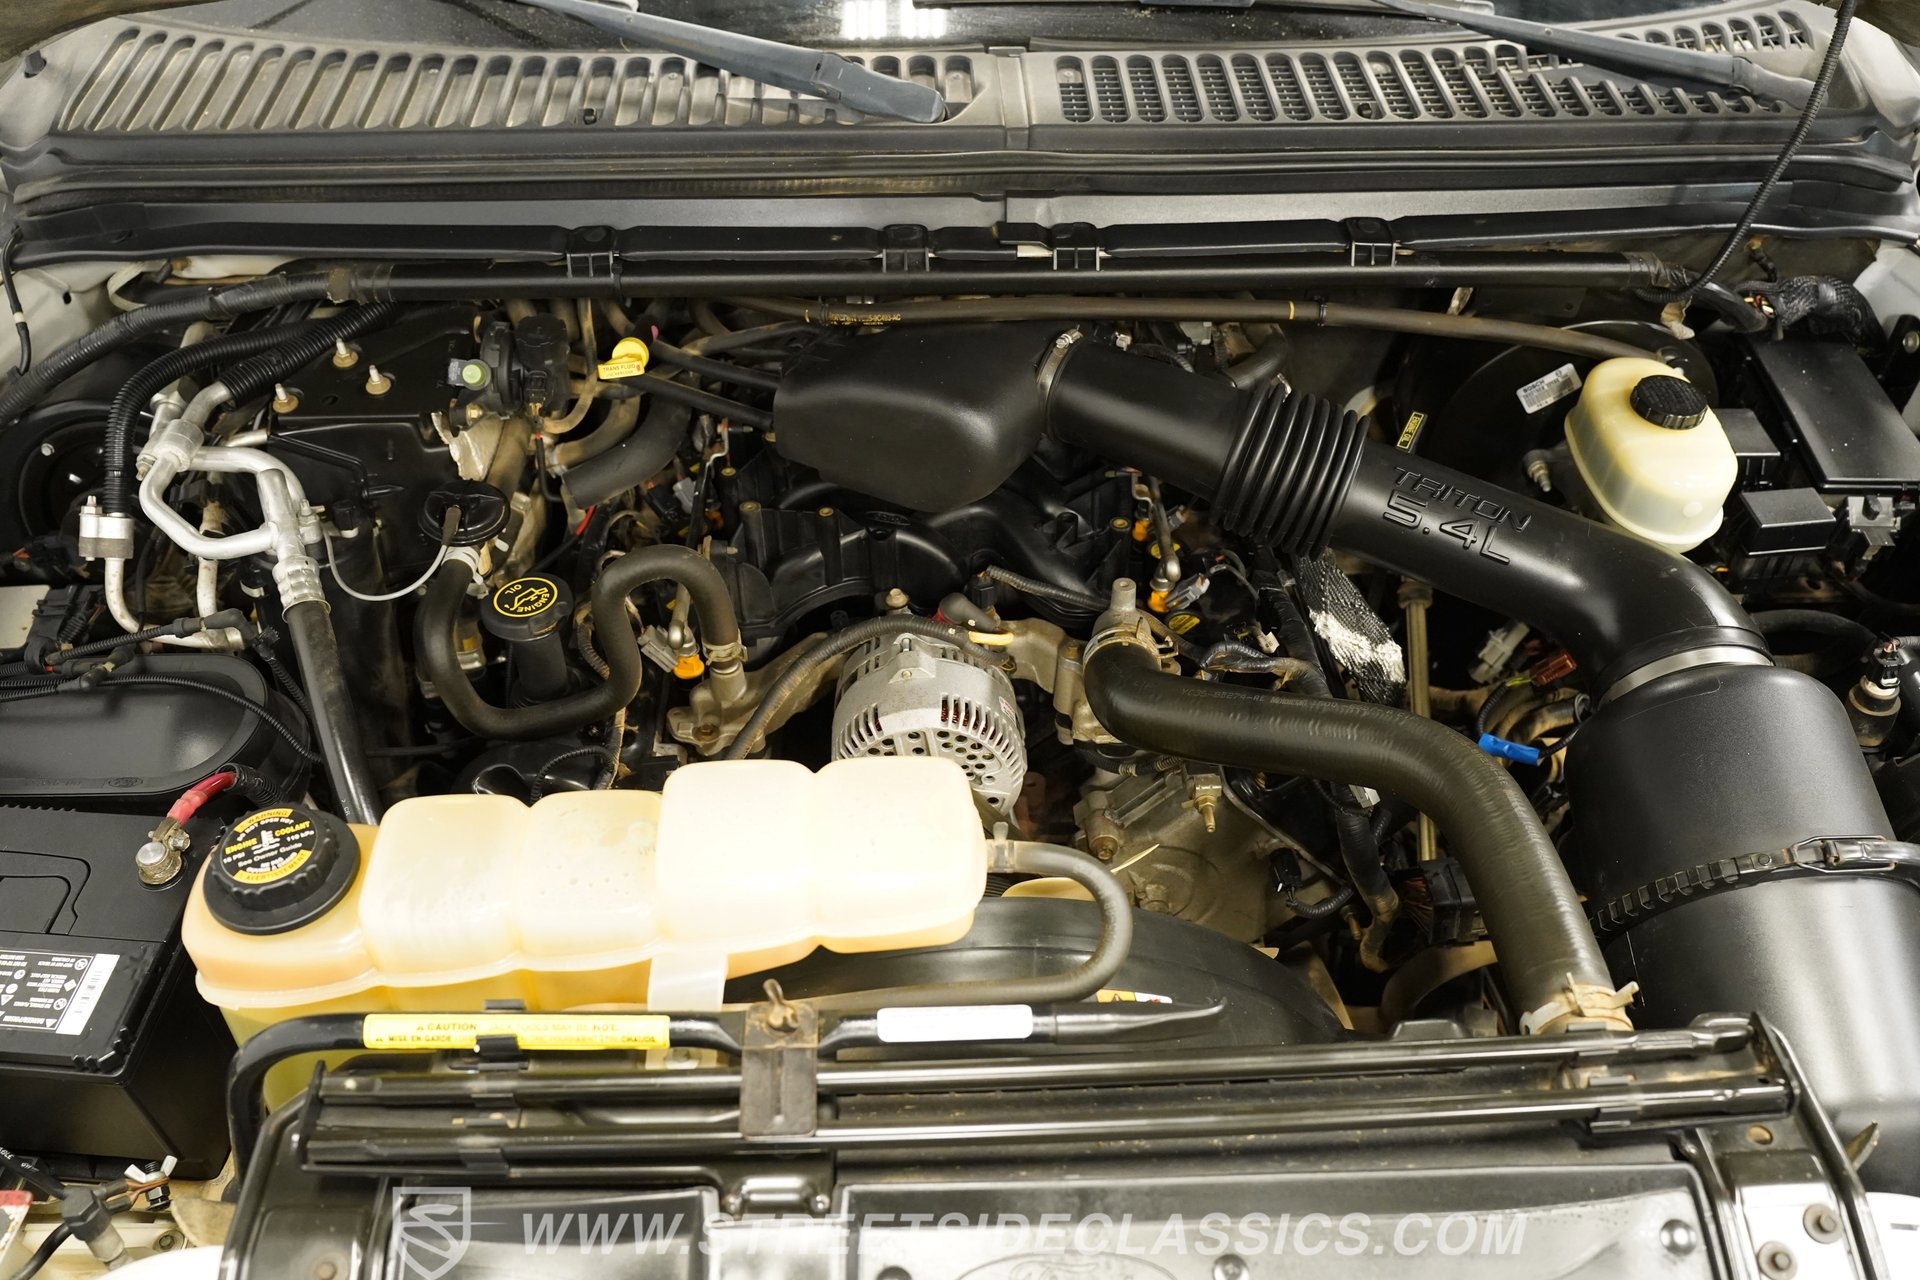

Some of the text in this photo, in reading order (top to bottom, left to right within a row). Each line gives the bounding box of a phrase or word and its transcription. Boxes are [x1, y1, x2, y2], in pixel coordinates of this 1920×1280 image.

[1522, 379, 1545, 394] BOSCH
[1394, 467, 1532, 532] TRITON
[1383, 489, 1511, 565] 5.4L
[504, 584, 522, 594] OIL
[516, 593, 550, 613] ENGINE
[247, 811, 289, 824] WARNING
[259, 817, 280, 826] OPEN
[225, 820, 311, 854] ENGINE COOLANT
[232, 851, 246, 861] PSI
[237, 858, 253, 868] See
[253, 849, 279, 862] Owner
[279, 842, 303, 854] Guide
[427, 1023, 477, 1031] CAUTION
[388, 1034, 408, 1042] MISE
[411, 1034, 422, 1042] EN
[424, 1034, 452, 1042] GARDE
